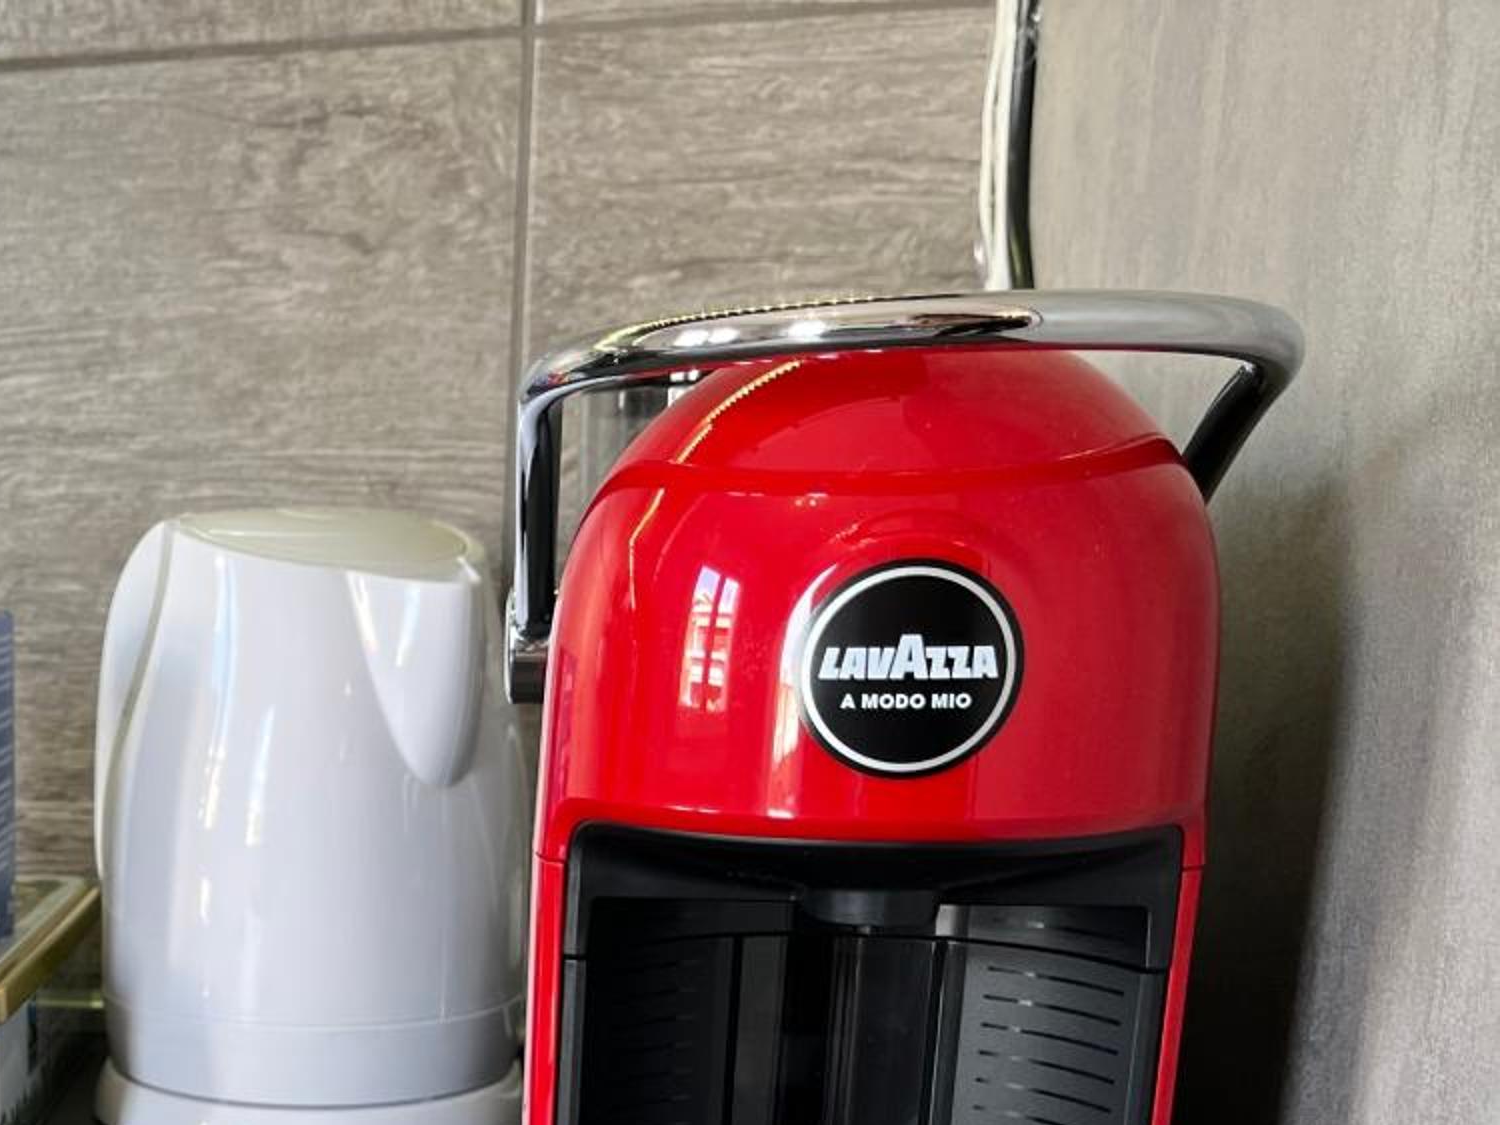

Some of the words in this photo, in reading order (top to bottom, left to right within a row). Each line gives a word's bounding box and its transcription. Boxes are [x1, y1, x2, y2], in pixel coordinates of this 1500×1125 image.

[817, 633, 999, 680] LAVAZZA
[840, 694, 856, 709] A
[861, 693, 927, 709] MODO
[931, 693, 973, 709] MIO
